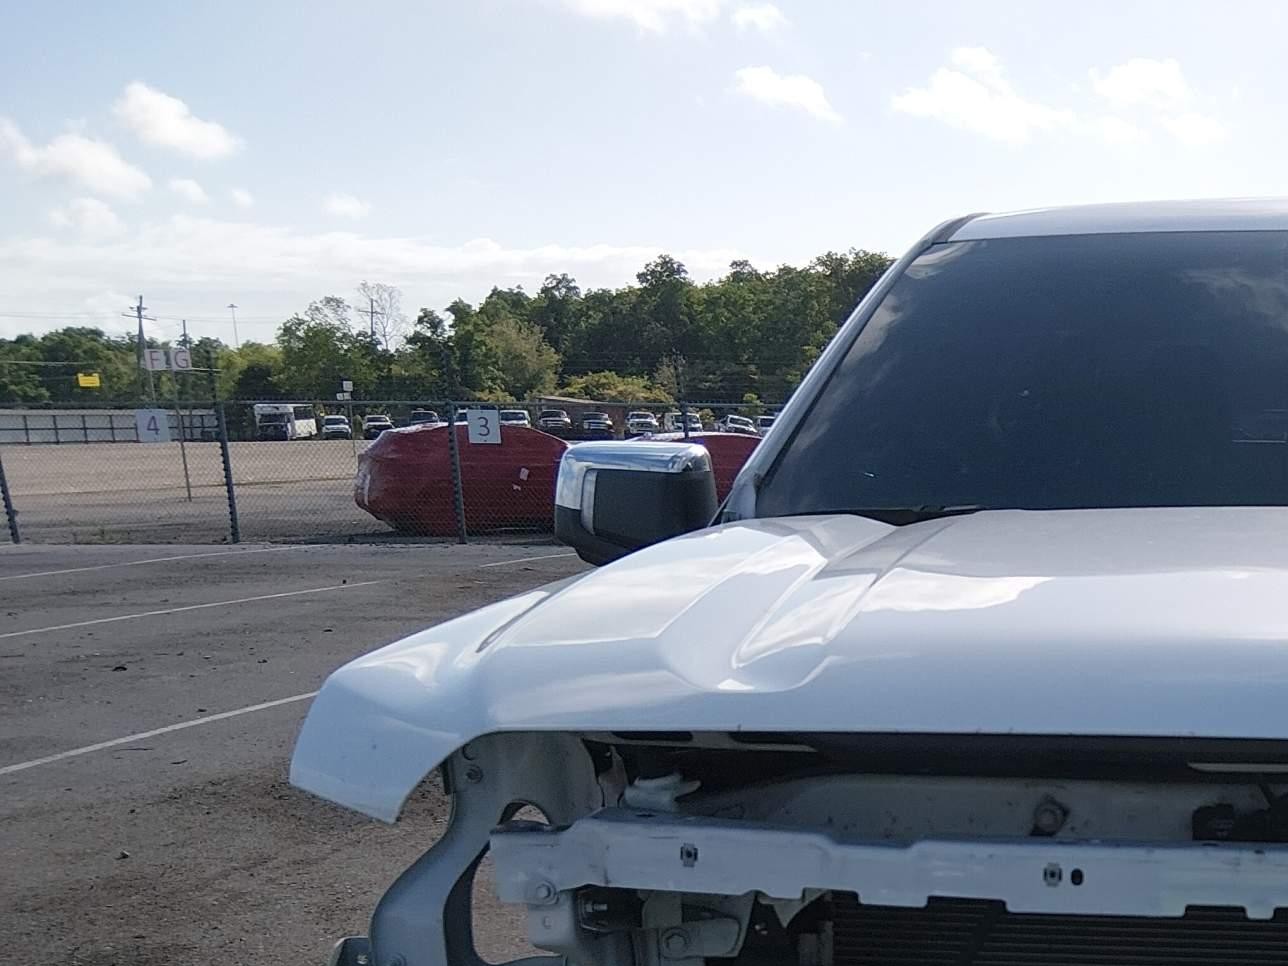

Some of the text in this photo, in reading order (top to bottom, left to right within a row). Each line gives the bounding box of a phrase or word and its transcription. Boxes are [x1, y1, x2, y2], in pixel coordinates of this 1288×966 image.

[149, 350, 161, 369] F
[174, 350, 190, 369] G
[146, 415, 161, 436] 4
[477, 416, 490, 437] 3
